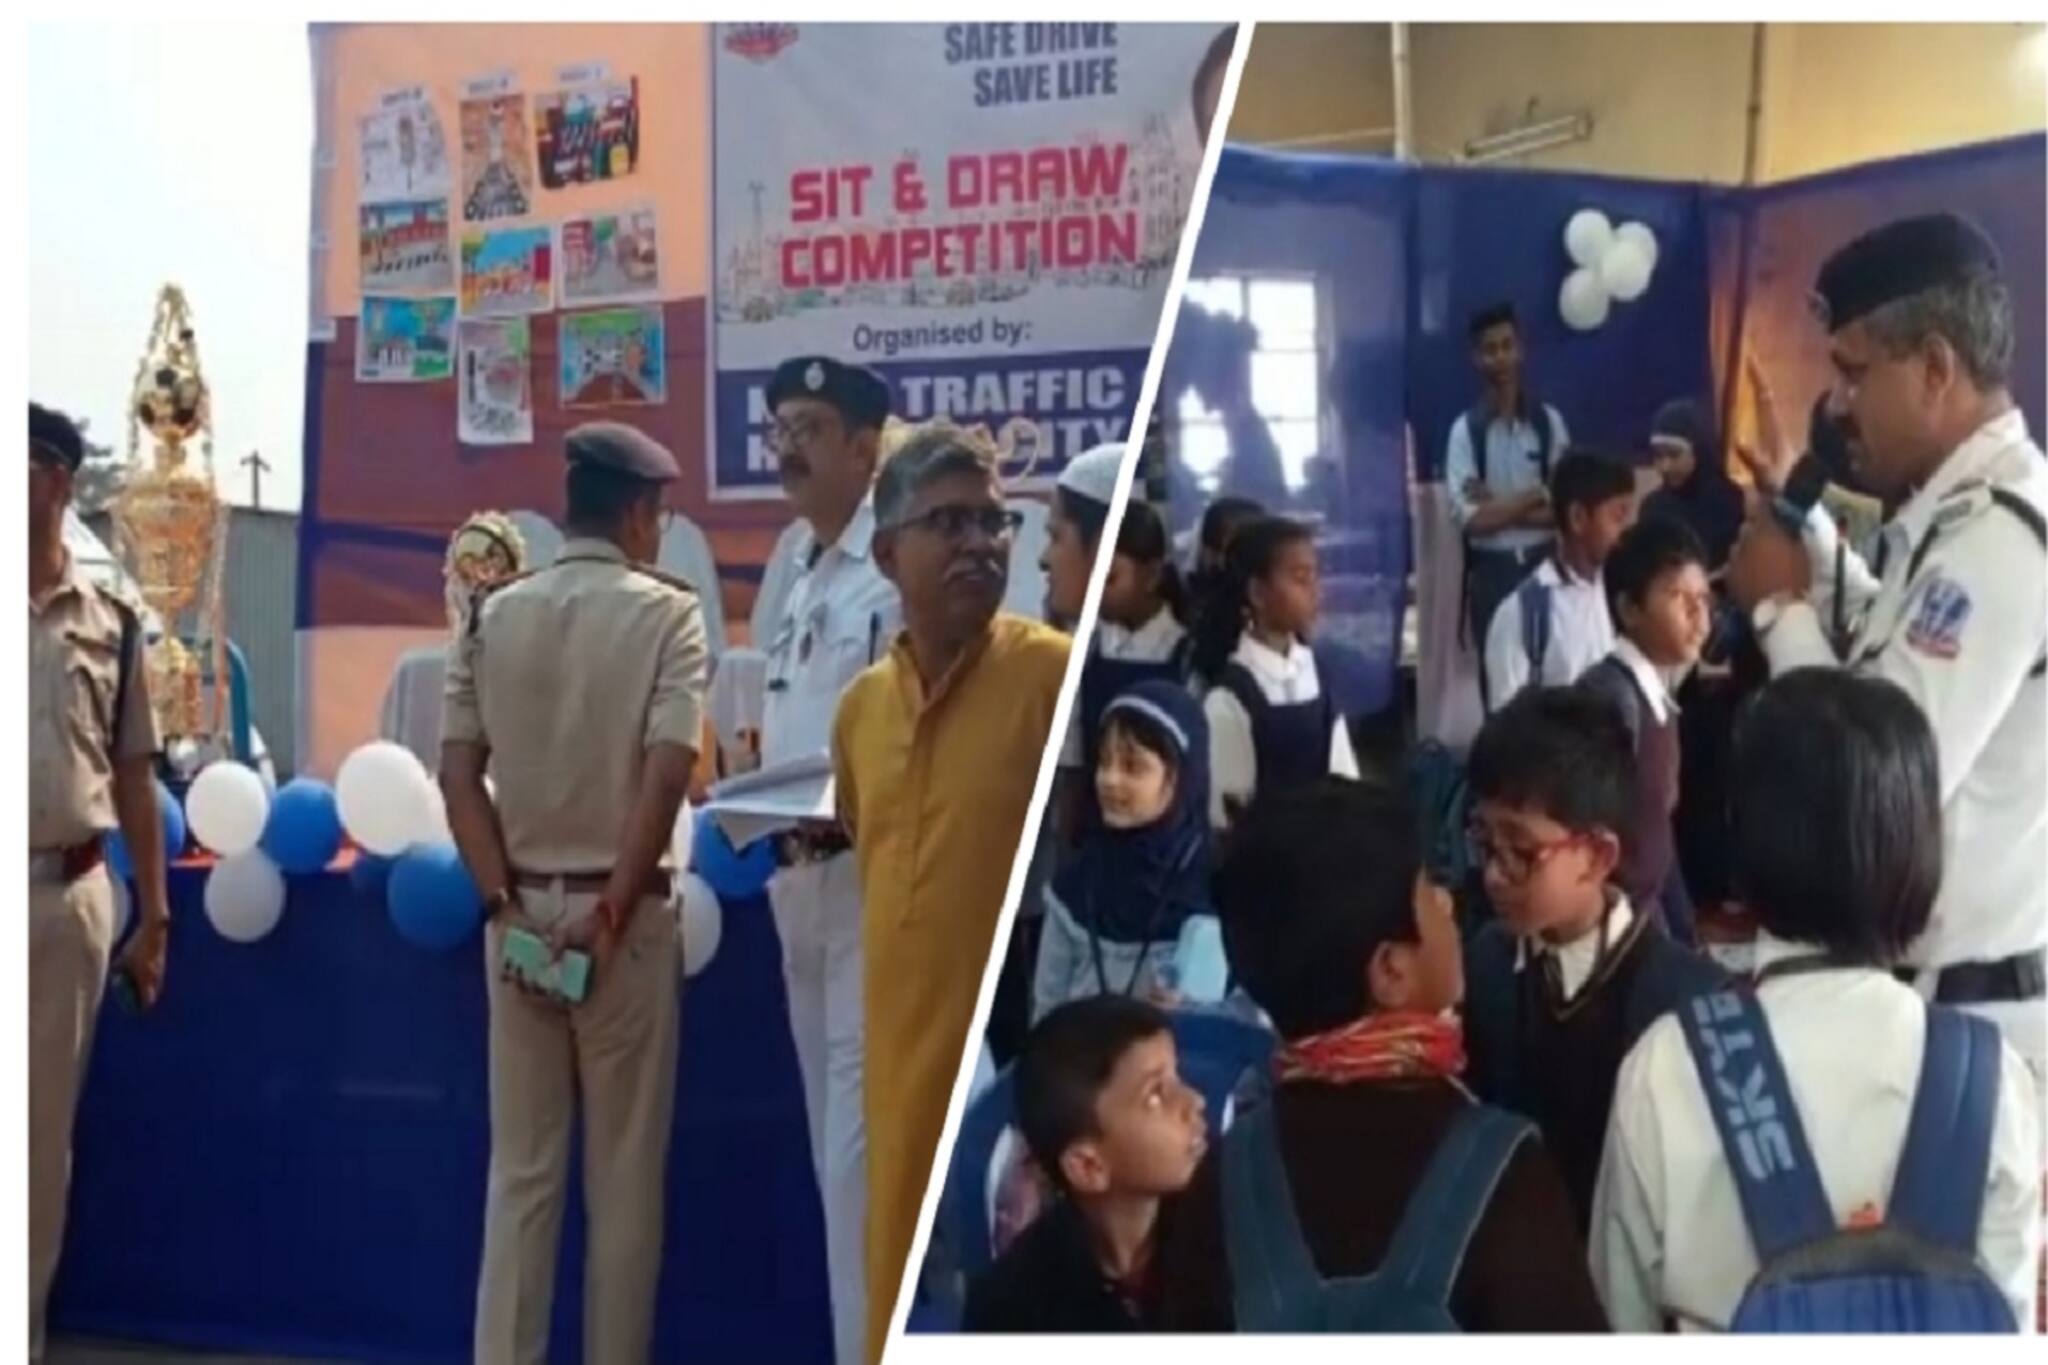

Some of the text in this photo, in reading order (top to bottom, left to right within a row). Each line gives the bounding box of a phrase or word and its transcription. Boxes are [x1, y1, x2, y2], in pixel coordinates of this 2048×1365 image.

[944, 22, 1118, 65] SAFE DRIVE
[974, 56, 1118, 108] SAVE LIFE
[790, 143, 1129, 222] SIT & DRAW
[782, 211, 1138, 289] COMPETITION
[853, 315, 1033, 356] Organised by:
[902, 366, 1126, 417] TRAFFIC
